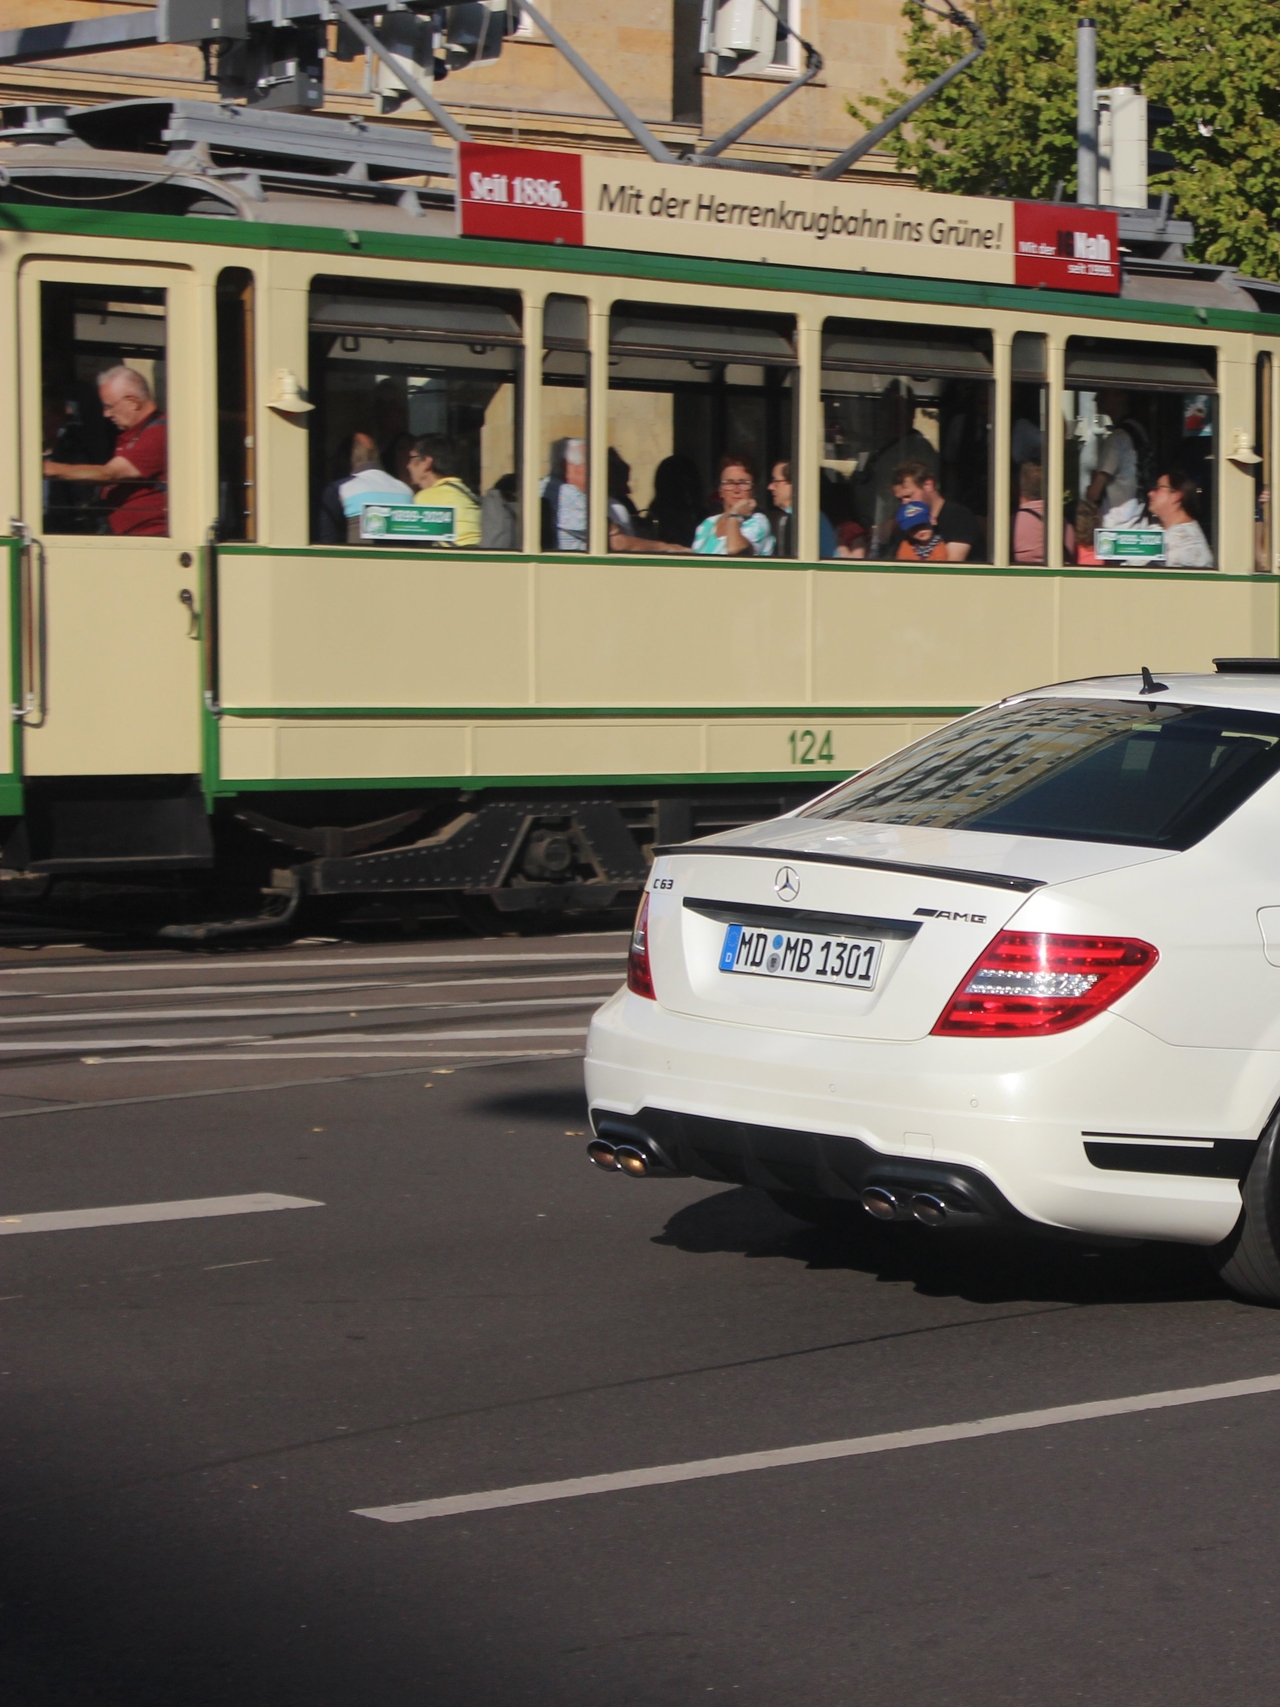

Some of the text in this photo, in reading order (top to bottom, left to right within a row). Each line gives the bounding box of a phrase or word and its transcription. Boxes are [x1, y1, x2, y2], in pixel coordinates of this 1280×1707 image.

[469, 171, 568, 208] Seit 1886.
[599, 183, 1003, 249] Mit der Herrenkrugbahn ins Grüne!
[788, 729, 835, 765] 124
[935, 910, 987, 924] AMG
[725, 952, 733, 963] D
[735, 931, 876, 981] MD MB 1301
